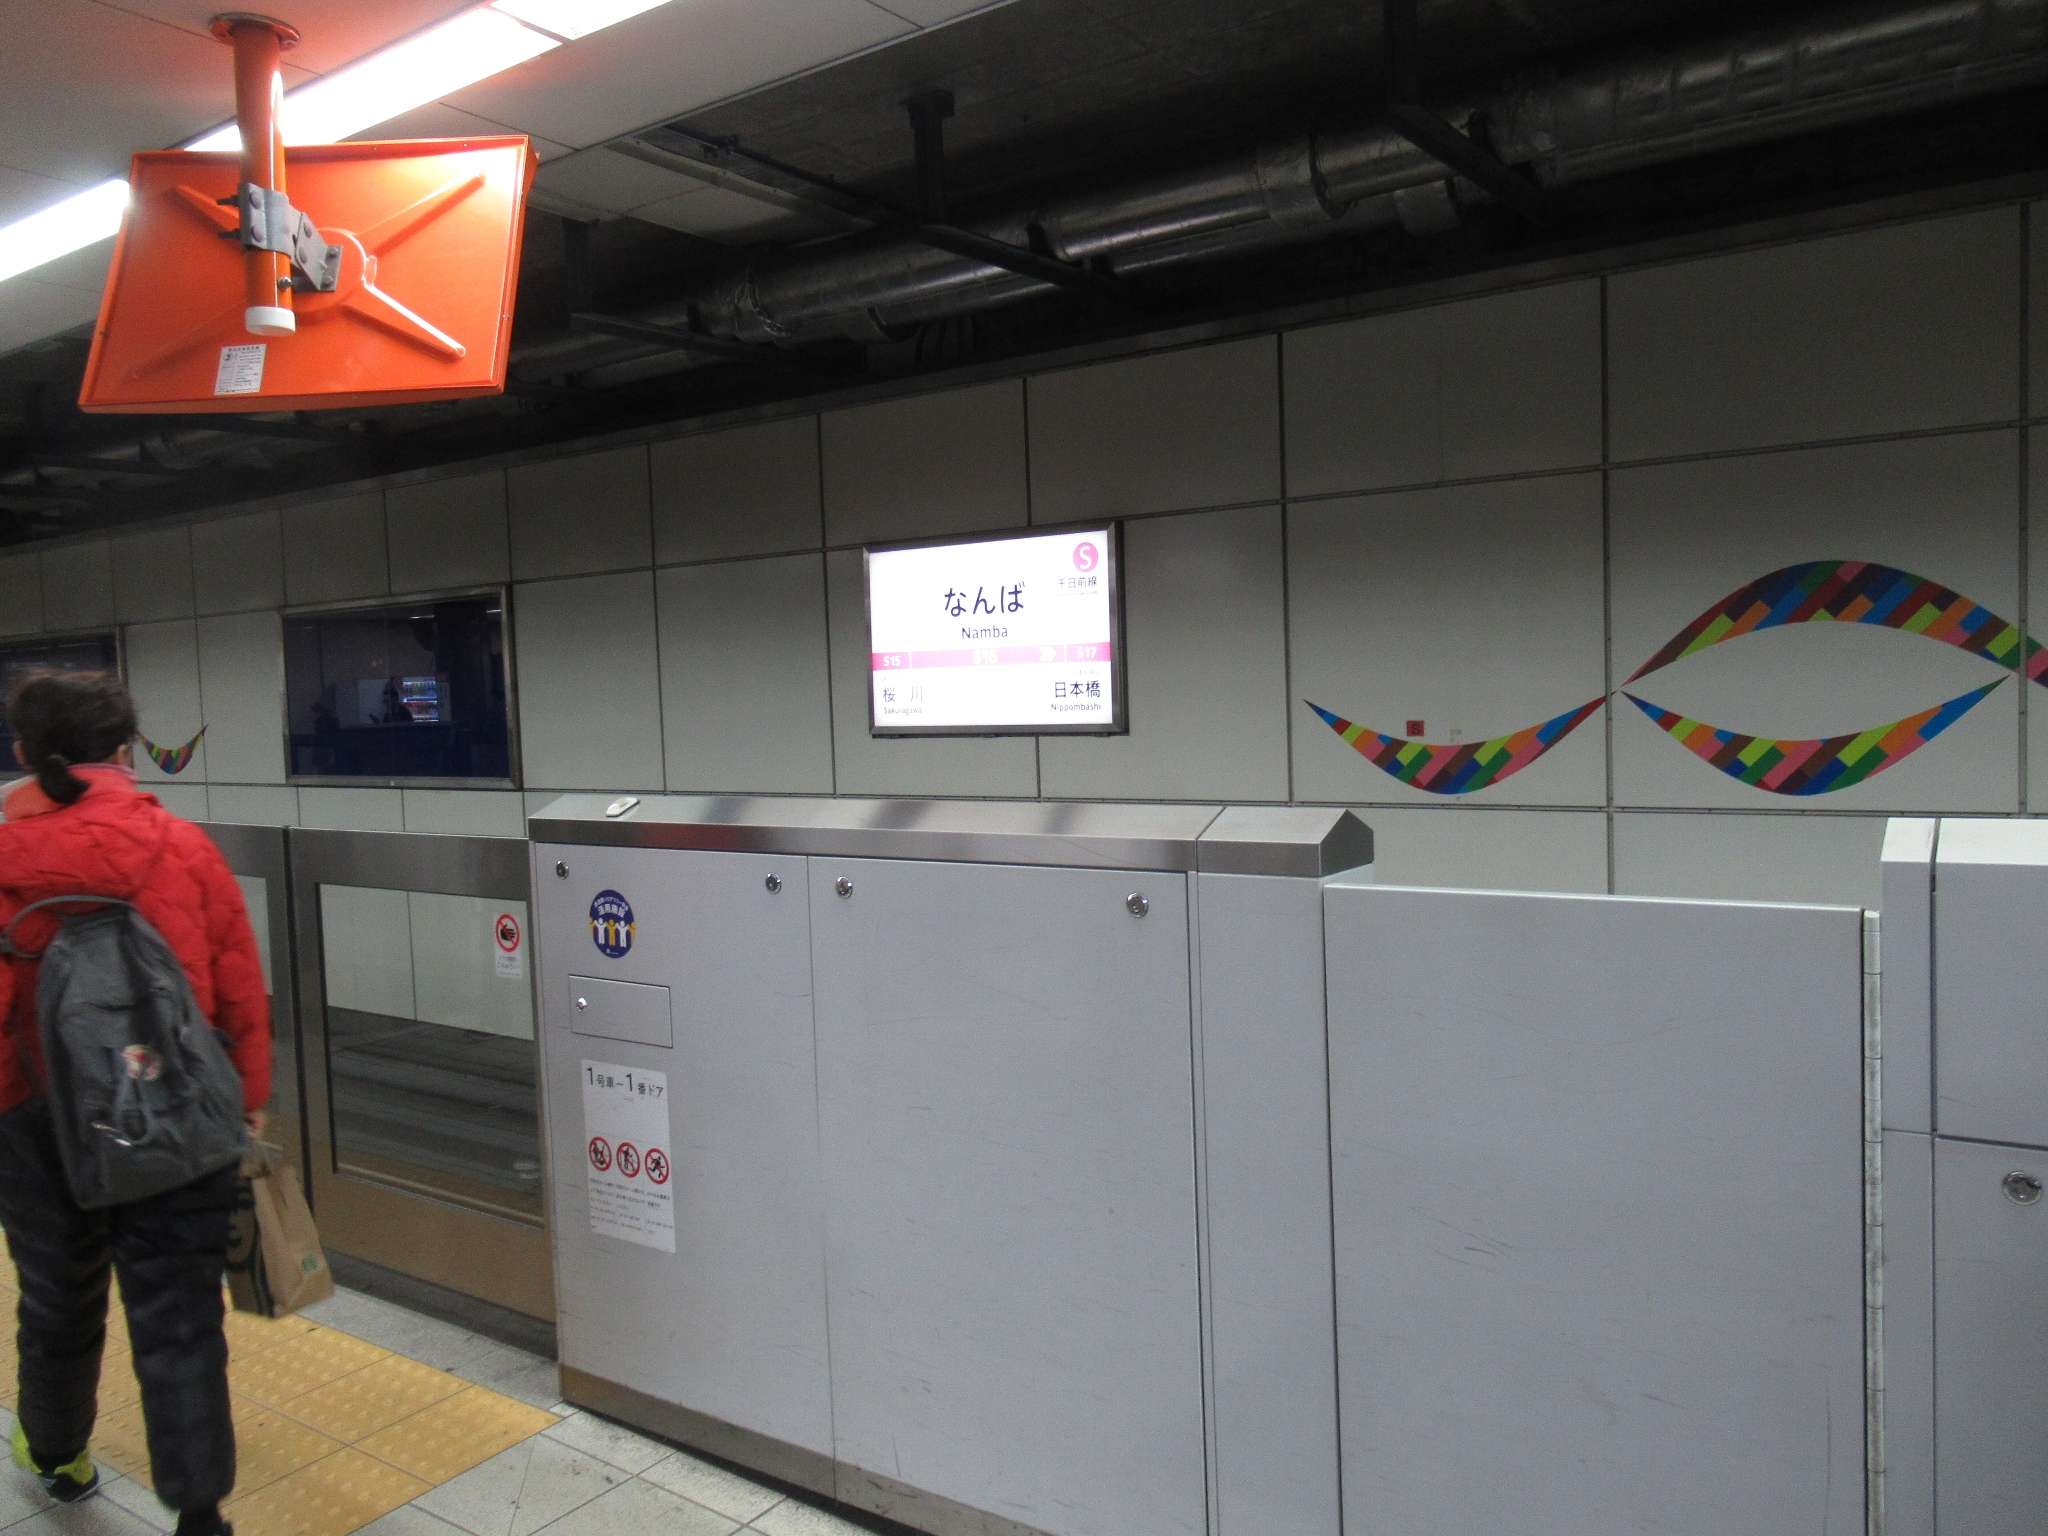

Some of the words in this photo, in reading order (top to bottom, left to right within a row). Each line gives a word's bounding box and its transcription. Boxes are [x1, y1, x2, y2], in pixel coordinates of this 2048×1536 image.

[1079, 545, 1093, 571] S
[944, 581, 1026, 617] なんば
[961, 624, 1008, 640] Namba
[882, 655, 902, 667] S15
[1076, 646, 1097, 659] S17
[1054, 680, 1101, 699] 日本橋
[1050, 702, 1102, 713] Nippombashi
